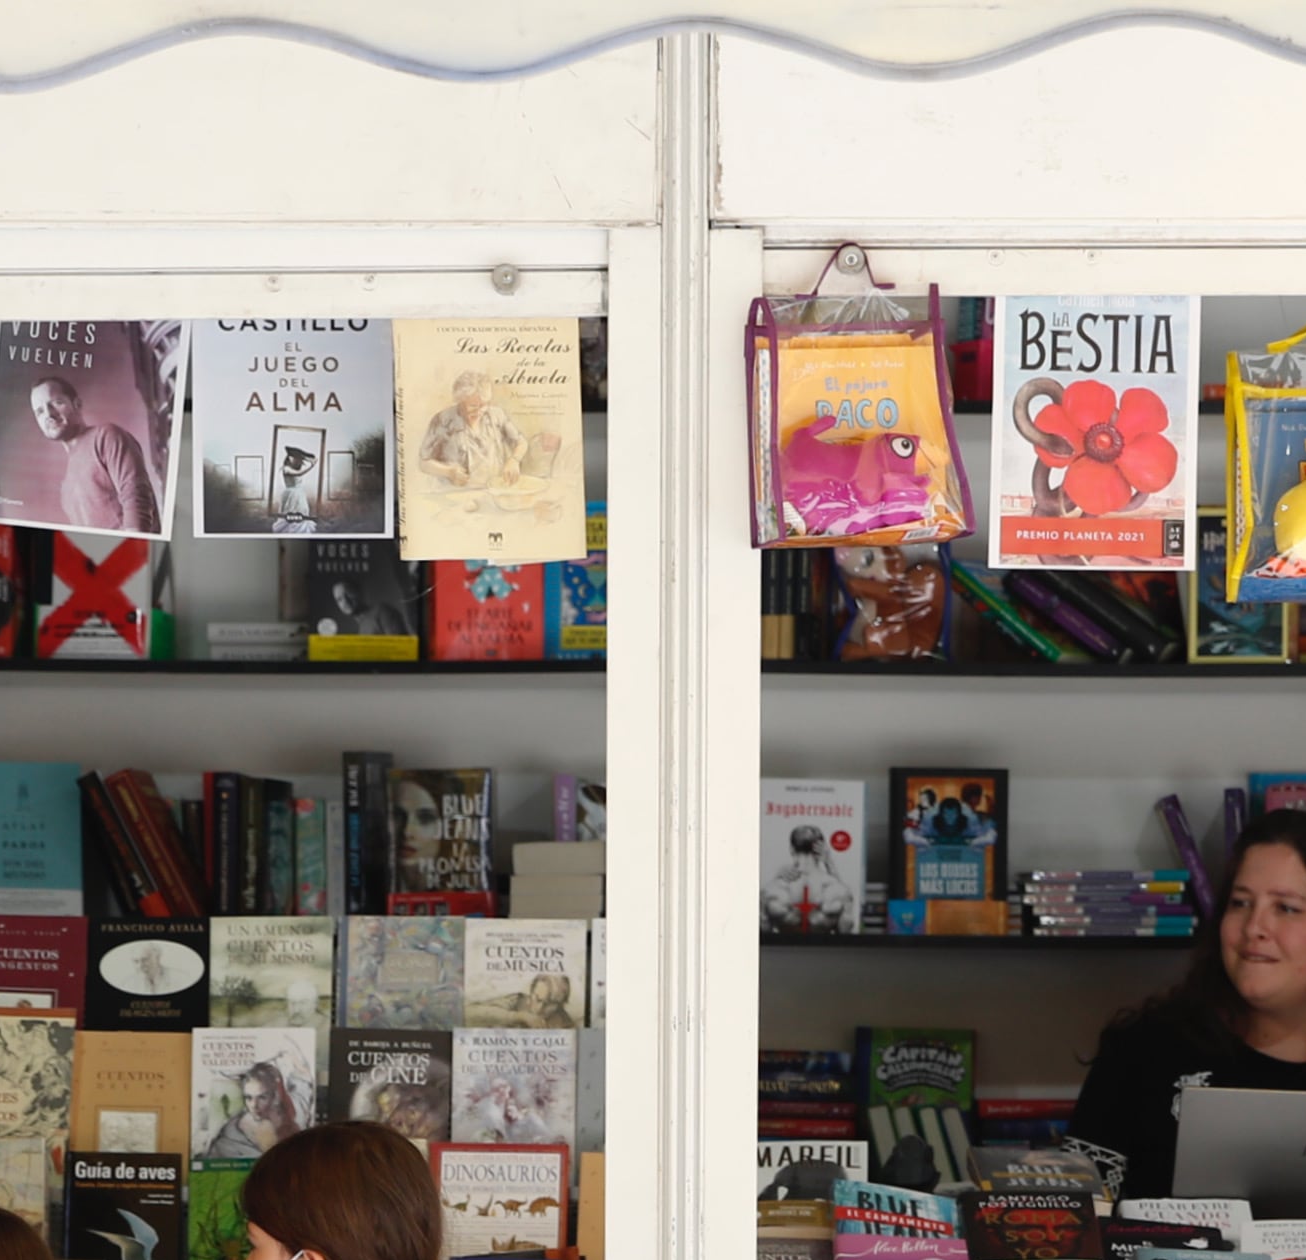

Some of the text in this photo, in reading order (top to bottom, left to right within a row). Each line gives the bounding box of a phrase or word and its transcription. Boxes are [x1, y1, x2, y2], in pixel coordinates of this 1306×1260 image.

[284, 341, 303, 352] EL
[1019, 307, 1177, 374] BESTIA
[8, 346, 95, 368] VUELVEN
[248, 355, 339, 373] JUEGO
[279, 378, 309, 388] DEL
[246, 391, 343, 413] ALMA
[1016, 530, 1145, 542] PREMIO PLANETA 2021
[485, 945, 565, 959] CUENTOS
[348, 1052, 431, 1067] CUENTOS
[369, 1065, 427, 1085] CINE
[74, 1160, 176, 1181] Guía de aves
[442, 1163, 558, 1183] DINOSAURIOS
[978, 1201, 1081, 1209] POSTEGUILLO
[846, 1209, 946, 1232] EL CAMPAMENTO
